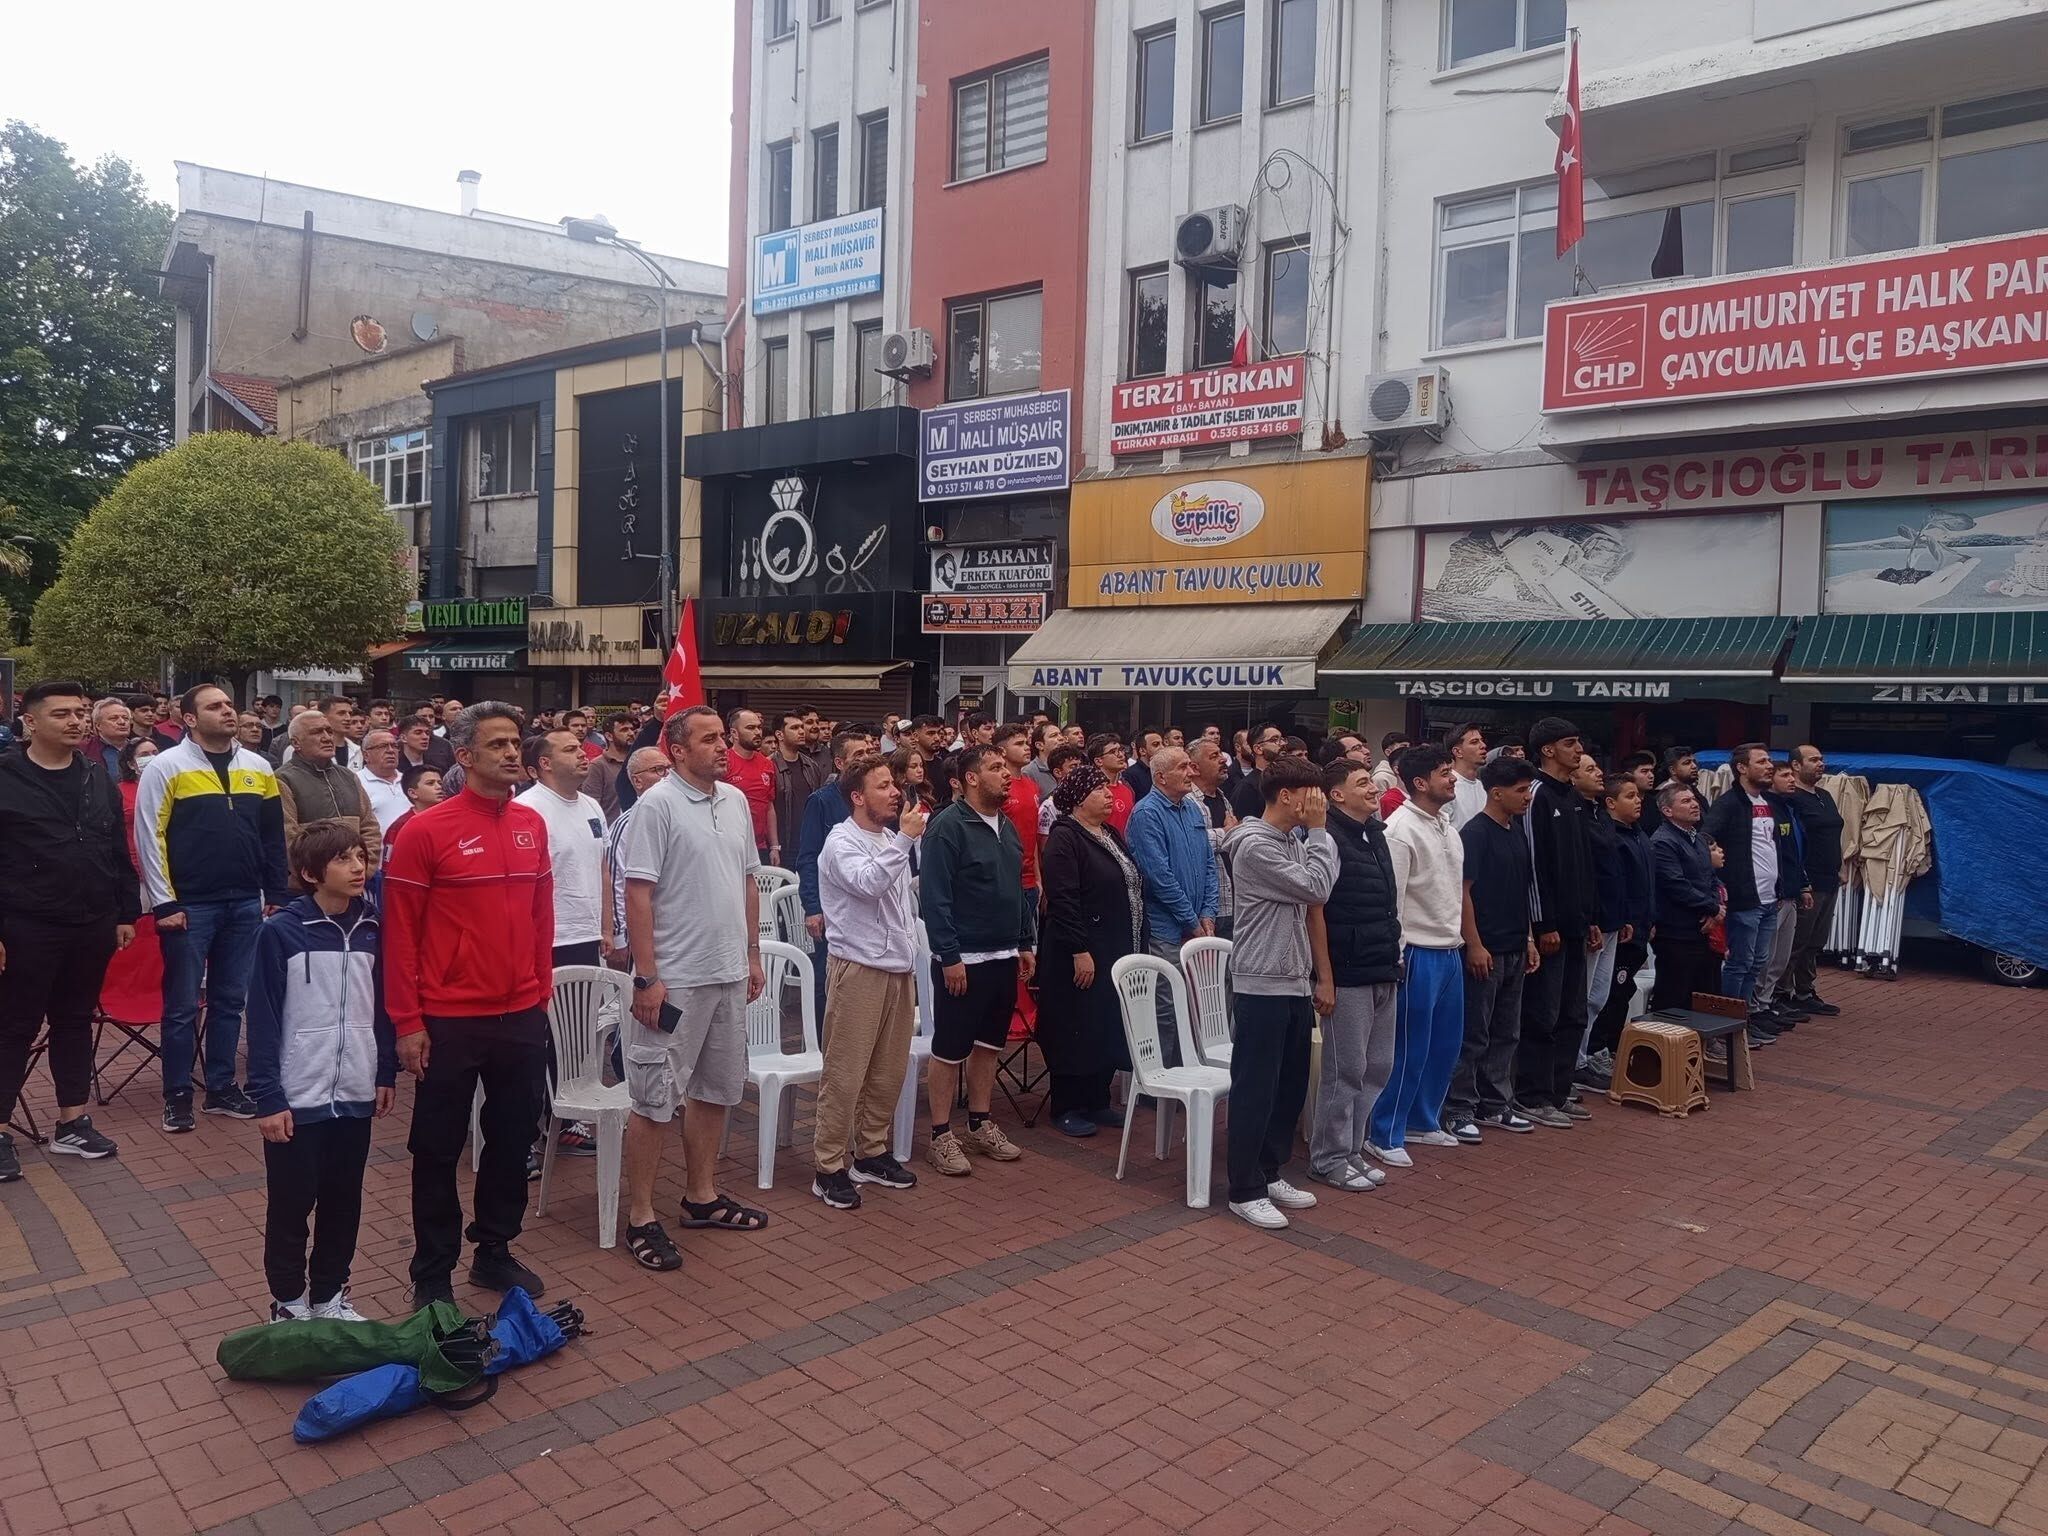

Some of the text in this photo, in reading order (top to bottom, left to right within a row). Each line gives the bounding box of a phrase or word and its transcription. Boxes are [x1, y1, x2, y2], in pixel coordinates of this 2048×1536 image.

[803, 228, 833, 244] SERBEST
[805, 234, 875, 263] MALİ MÜŞAVİR
[1659, 281, 1866, 341] CUMHURİYET
[1876, 266, 1975, 314] HALK
[1660, 309, 2048, 390] ÇAYCUMA İLÇE BAŞKAN
[1190, 364, 1294, 400] TÜRKAN
[1573, 361, 1636, 389] CHP
[963, 399, 1061, 425] SERBEST MUHASEBECİ
[1172, 419, 1179, 431] &
[1257, 403, 1297, 420] YAPILIR
[930, 426, 948, 451] M
[960, 416, 1063, 451] MALİ MÜŞAVİR
[1240, 424, 1260, 436] 863
[1261, 423, 1273, 433] 41
[1275, 421, 1289, 433] 66
[930, 451, 1058, 479] SEYHAN DÜZMEN
[937, 484, 943, 494] 0
[944, 483, 958, 494] 537
[960, 482, 972, 492] 571
[974, 481, 984, 491] 48
[986, 479, 995, 490] 78
[1577, 447, 1884, 511] TAŞCIOĞLU
[1175, 503, 1237, 533] erpiliç
[977, 547, 1038, 566] BARAN
[1536, 540, 1554, 556] STIHL
[960, 565, 1050, 582] ERKEK KUAFÖRÜ
[1099, 561, 1323, 596] ABANT TAVUKÇULUK
[427, 597, 527, 629] YEŞİL ÇİFTLİĞİ
[949, 599, 1040, 619] TERZİ
[450, 654, 507, 671] ÇİFTLİĞİ
[1031, 665, 1285, 690] ABANT TAVUKÇULUK
[1395, 678, 1670, 698] TAŞCIOĞLU TARIM
